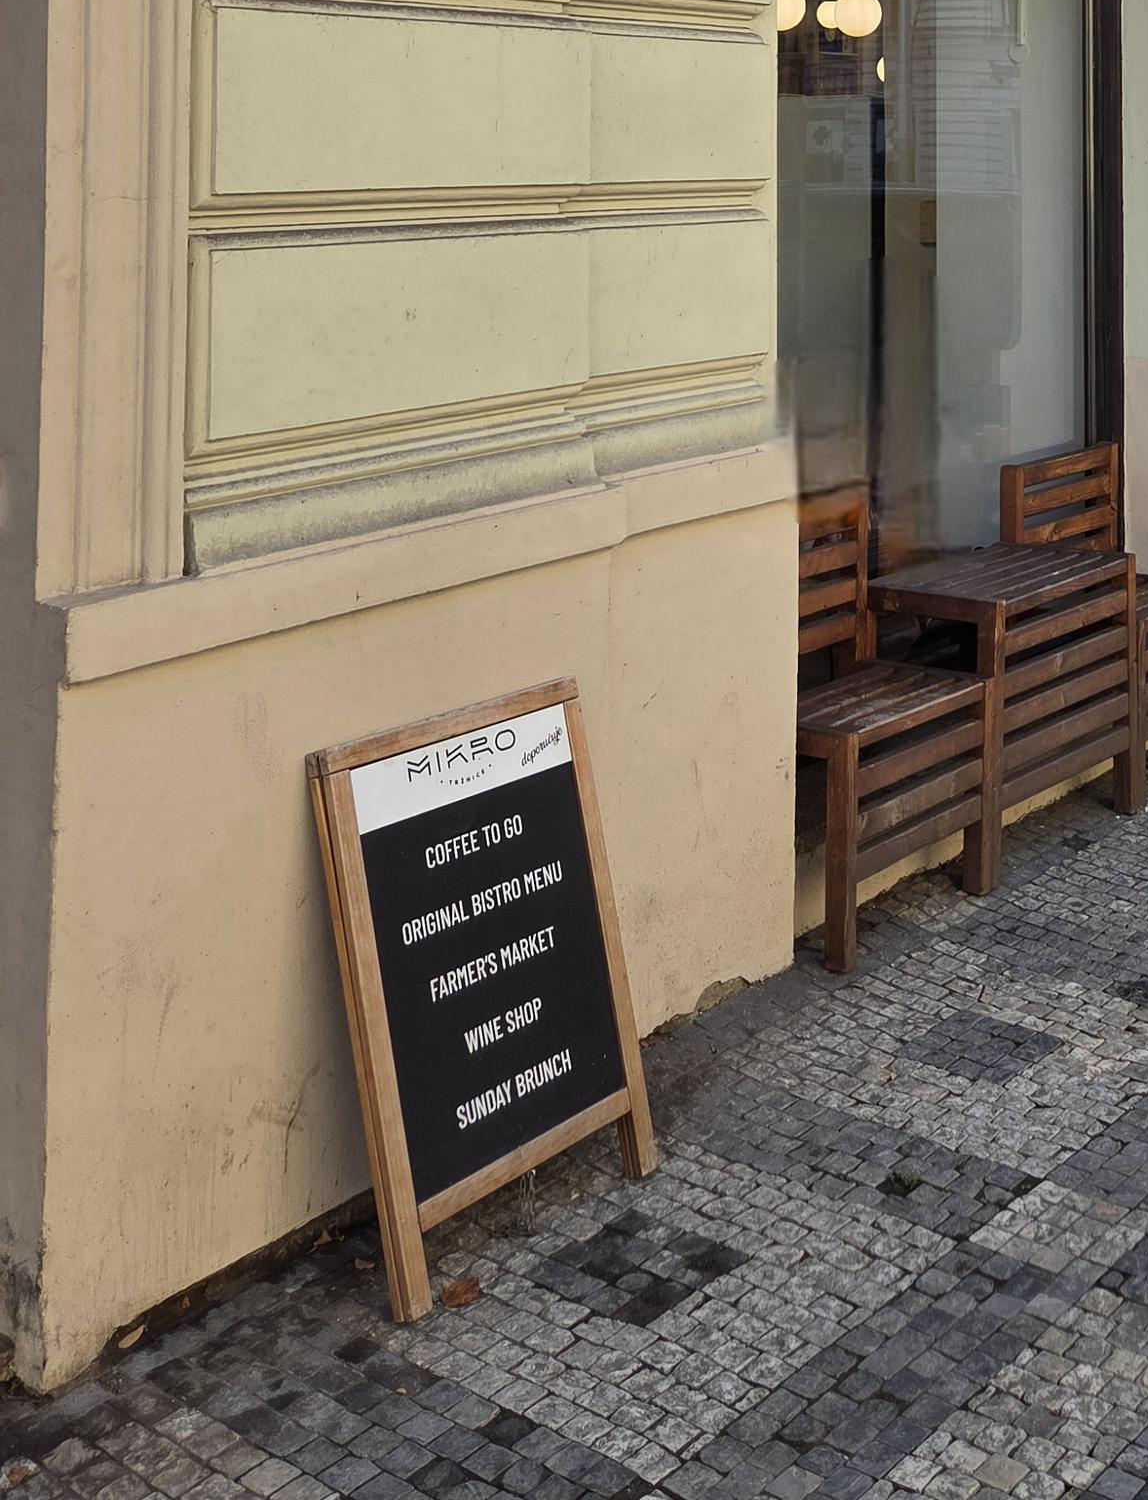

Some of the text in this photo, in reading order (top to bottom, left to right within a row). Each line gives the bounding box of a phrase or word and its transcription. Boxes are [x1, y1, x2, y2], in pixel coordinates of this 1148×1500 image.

[406, 728, 516, 783] MIKRO
[424, 814, 524, 869] COFFEE TO GO
[401, 860, 564, 946] ORIGINAL BISTRO MENU
[429, 926, 556, 1003] FARMER'S MARKET
[463, 997, 543, 1054] WINE SHOP
[455, 1048, 573, 1130] SUNDAY BRUNCH
